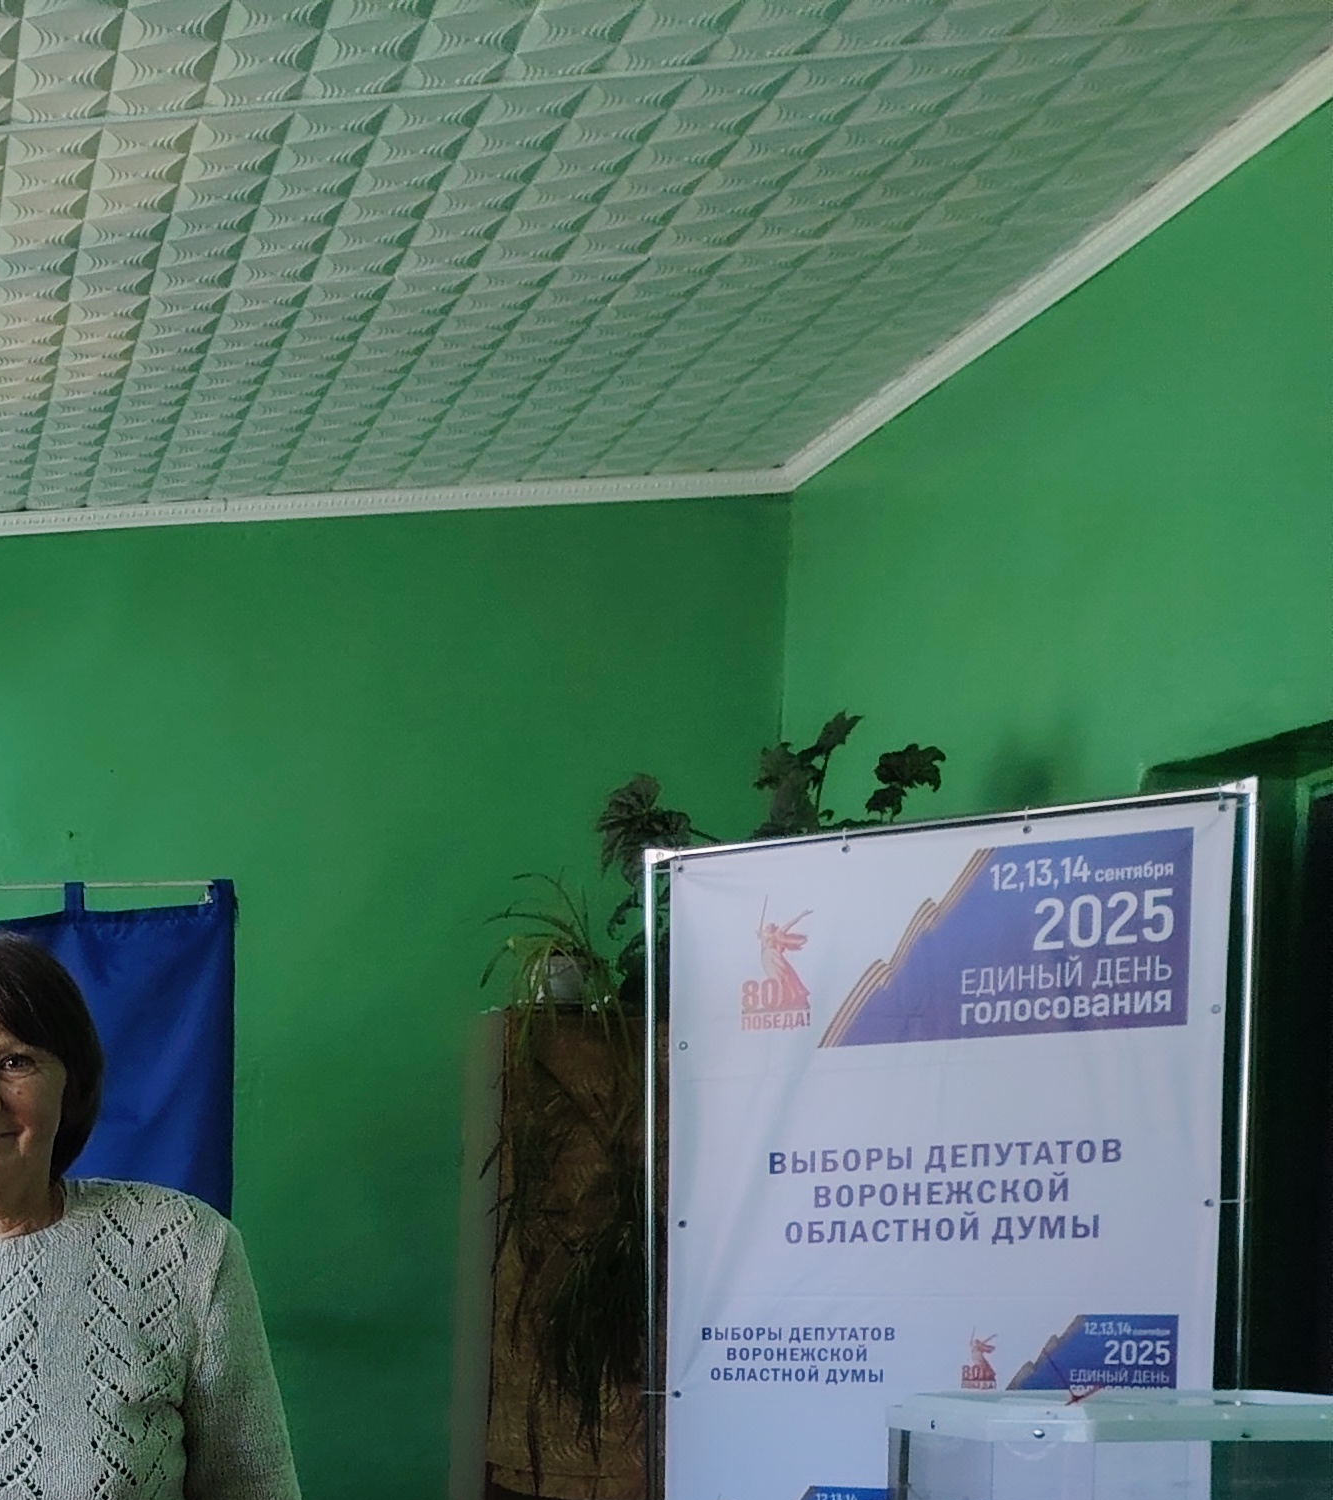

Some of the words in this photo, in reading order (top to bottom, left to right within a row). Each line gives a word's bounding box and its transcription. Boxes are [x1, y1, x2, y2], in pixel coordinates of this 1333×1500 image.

[990, 855, 1091, 892] 12,13,14
[1094, 860, 1174, 882] сентября
[1033, 888, 1175, 950] 2025
[961, 955, 1082, 997] ЕДИНЫЙ
[1092, 955, 1172, 989] ДЕНЬ
[741, 979, 780, 1014] 80
[960, 990, 1172, 1025] голосования
[741, 1012, 811, 1031] ПОБЕДА!
[769, 1146, 913, 1175] ВЫБОРЫ
[924, 1138, 1123, 1174] ДЕПУТАТОВ
[813, 1171, 1070, 1209] ВОРОНЕЖСКОЙ
[785, 1211, 980, 1245] ОБЛАСТНОЙ
[991, 1214, 1101, 1246] ДУМЫ
[701, 1326, 783, 1341] ВЫБОРЫ
[788, 1326, 896, 1344] ДЕПУТАТОВ
[1103, 1339, 1171, 1366] 2025
[726, 1344, 868, 1362] ВОРОНЕЖСКОЙ
[710, 1365, 819, 1383] ОБЛАСТНОЙ
[825, 1368, 884, 1386] ДУМЫ
[1069, 1367, 1129, 1385] ЕДИНЫЙ
[1131, 1368, 1170, 1385] ДЕНЬ
